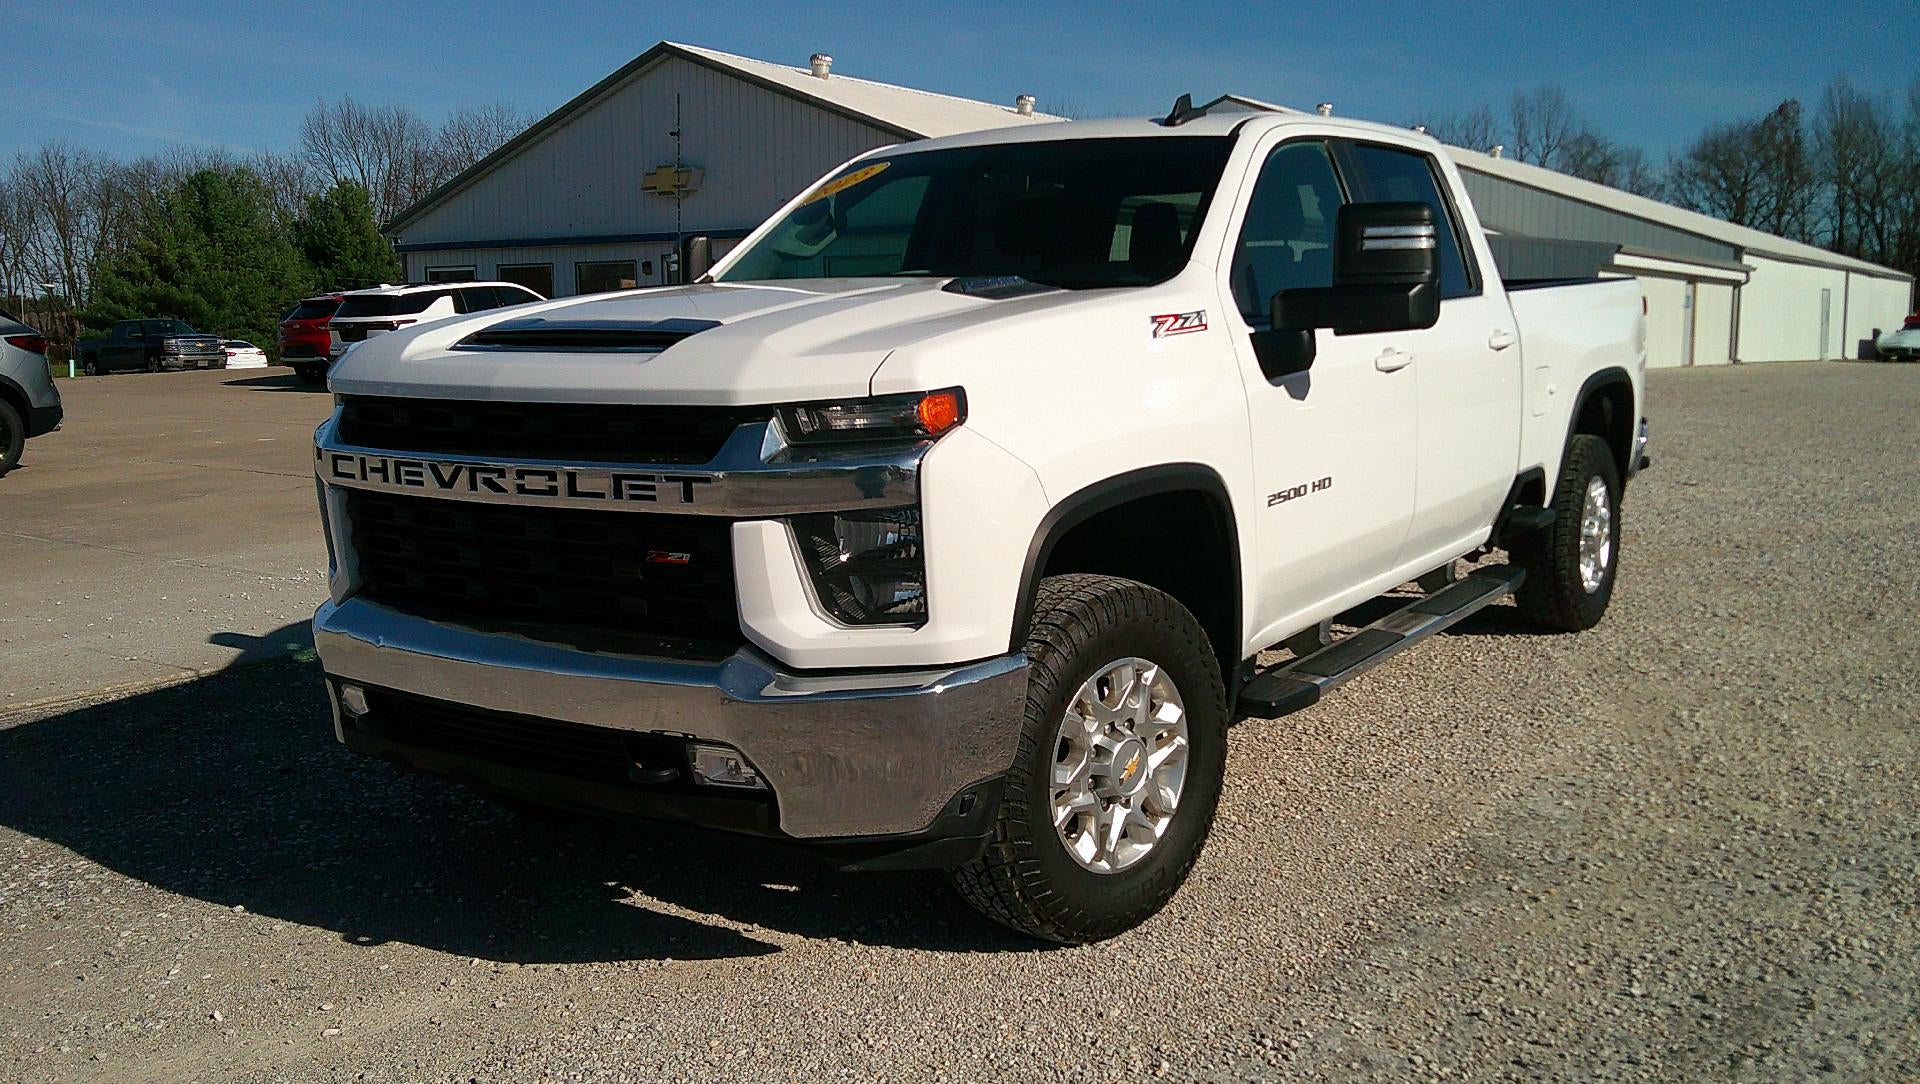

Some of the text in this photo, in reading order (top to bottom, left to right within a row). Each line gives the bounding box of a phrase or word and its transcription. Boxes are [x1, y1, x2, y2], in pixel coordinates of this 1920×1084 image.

[1150, 310, 1208, 338] Z71
[331, 453, 712, 503] CHEVROLET
[1266, 476, 1332, 508] 2500 HD
